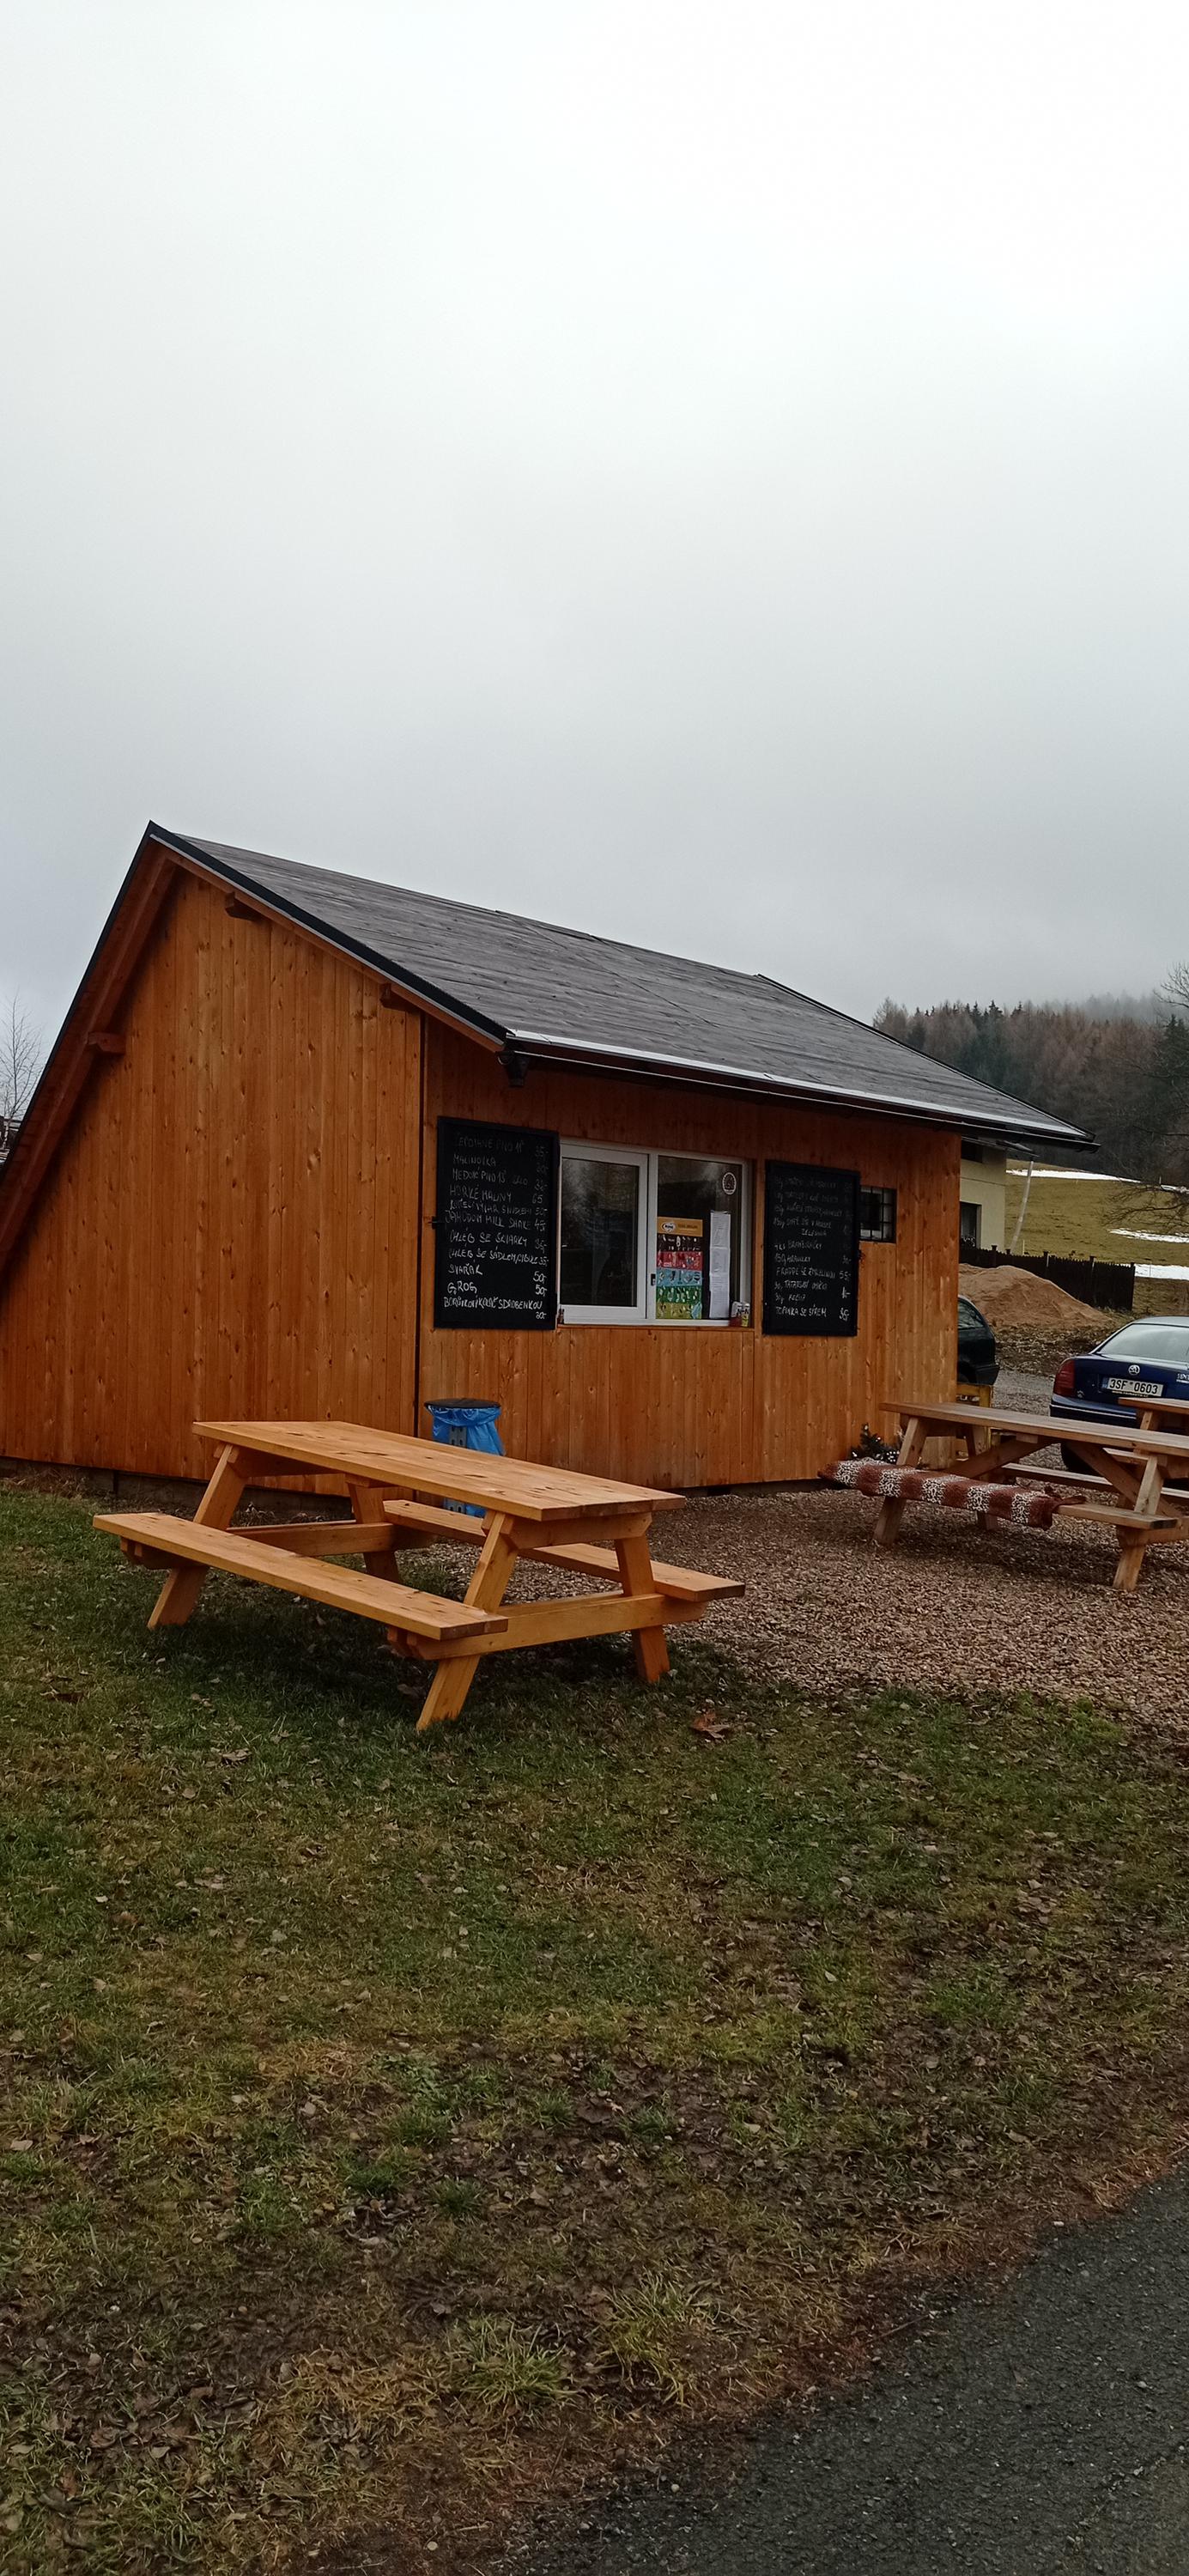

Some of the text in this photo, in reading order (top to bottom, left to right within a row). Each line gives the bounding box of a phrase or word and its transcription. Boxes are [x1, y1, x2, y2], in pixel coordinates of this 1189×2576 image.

[449, 1227, 476, 1243] CHLÉB
[479, 1231, 492, 1242] SE
[448, 1243, 474, 1259] CHLÉB
[476, 1248, 488, 1259] SE
[447, 1259, 483, 1276] SVAŘÁK
[447, 1280, 477, 1296] GROG
[799, 1307, 808, 1317] SE
[1109, 1379, 1158, 1394] 3SF 0603
